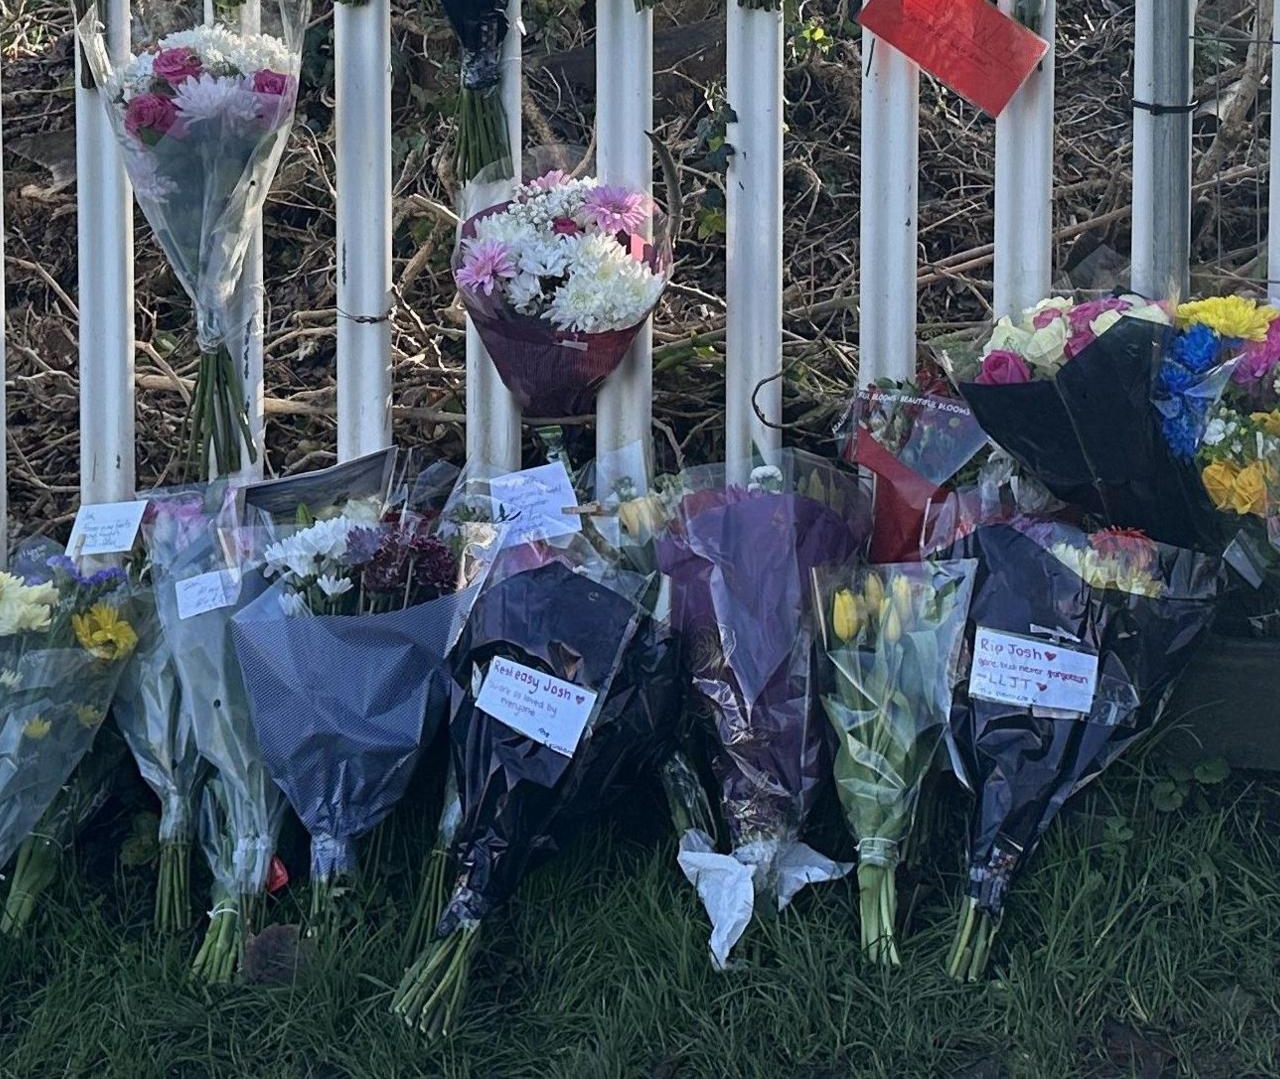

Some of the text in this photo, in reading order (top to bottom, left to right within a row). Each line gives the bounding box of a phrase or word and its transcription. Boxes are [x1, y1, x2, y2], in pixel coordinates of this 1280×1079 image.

[938, 402, 971, 416] BLOOMS
[1007, 643, 1042, 660] Josh
[1019, 664, 1043, 675] never
[494, 660, 571, 700] Rest easy Josh
